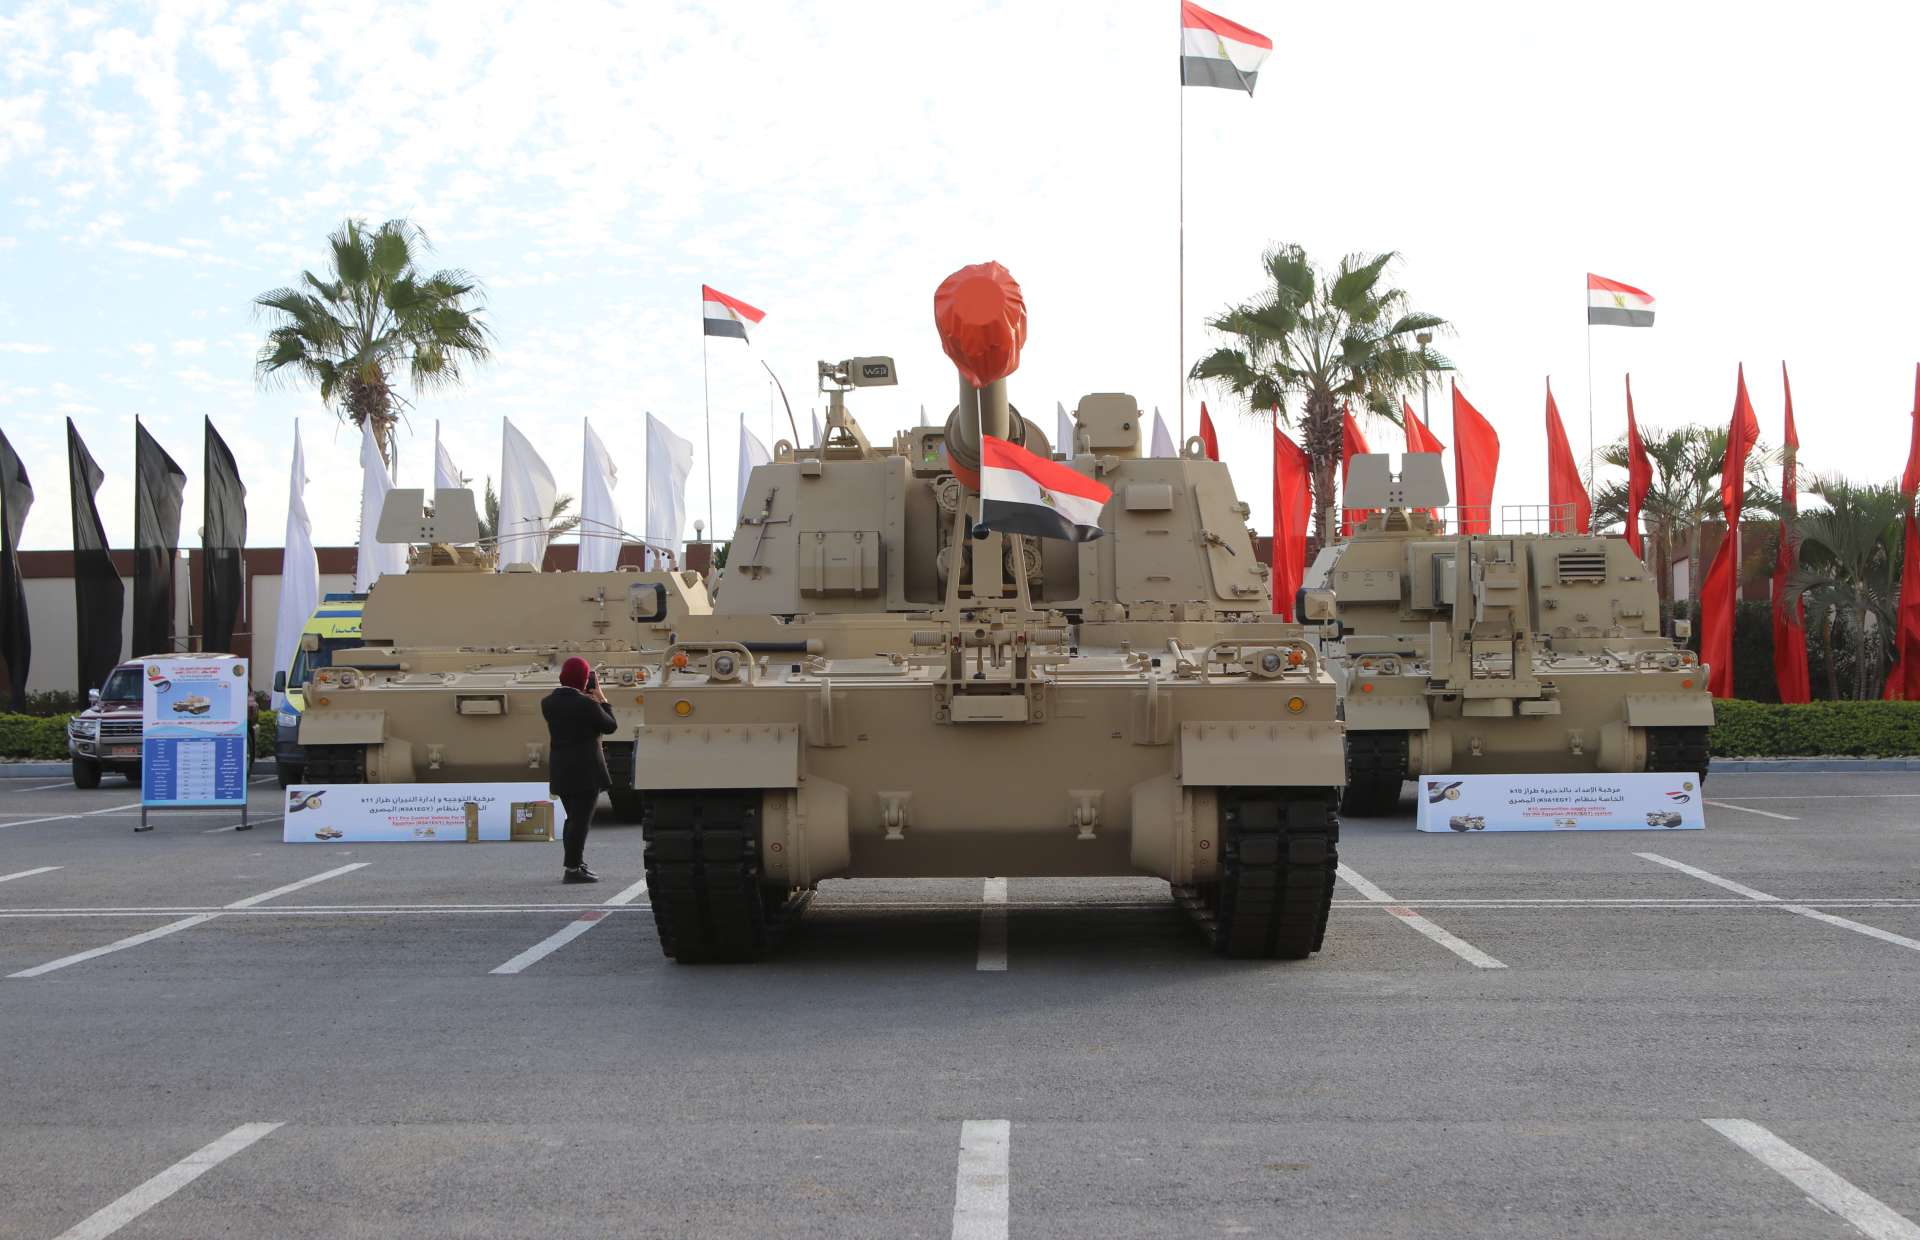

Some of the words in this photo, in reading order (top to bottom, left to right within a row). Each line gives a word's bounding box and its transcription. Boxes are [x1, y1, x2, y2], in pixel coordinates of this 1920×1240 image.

[1524, 787, 1539, 795] طراز
[1599, 786, 1621, 794] مركبة
[443, 795, 471, 803] التوجيه
